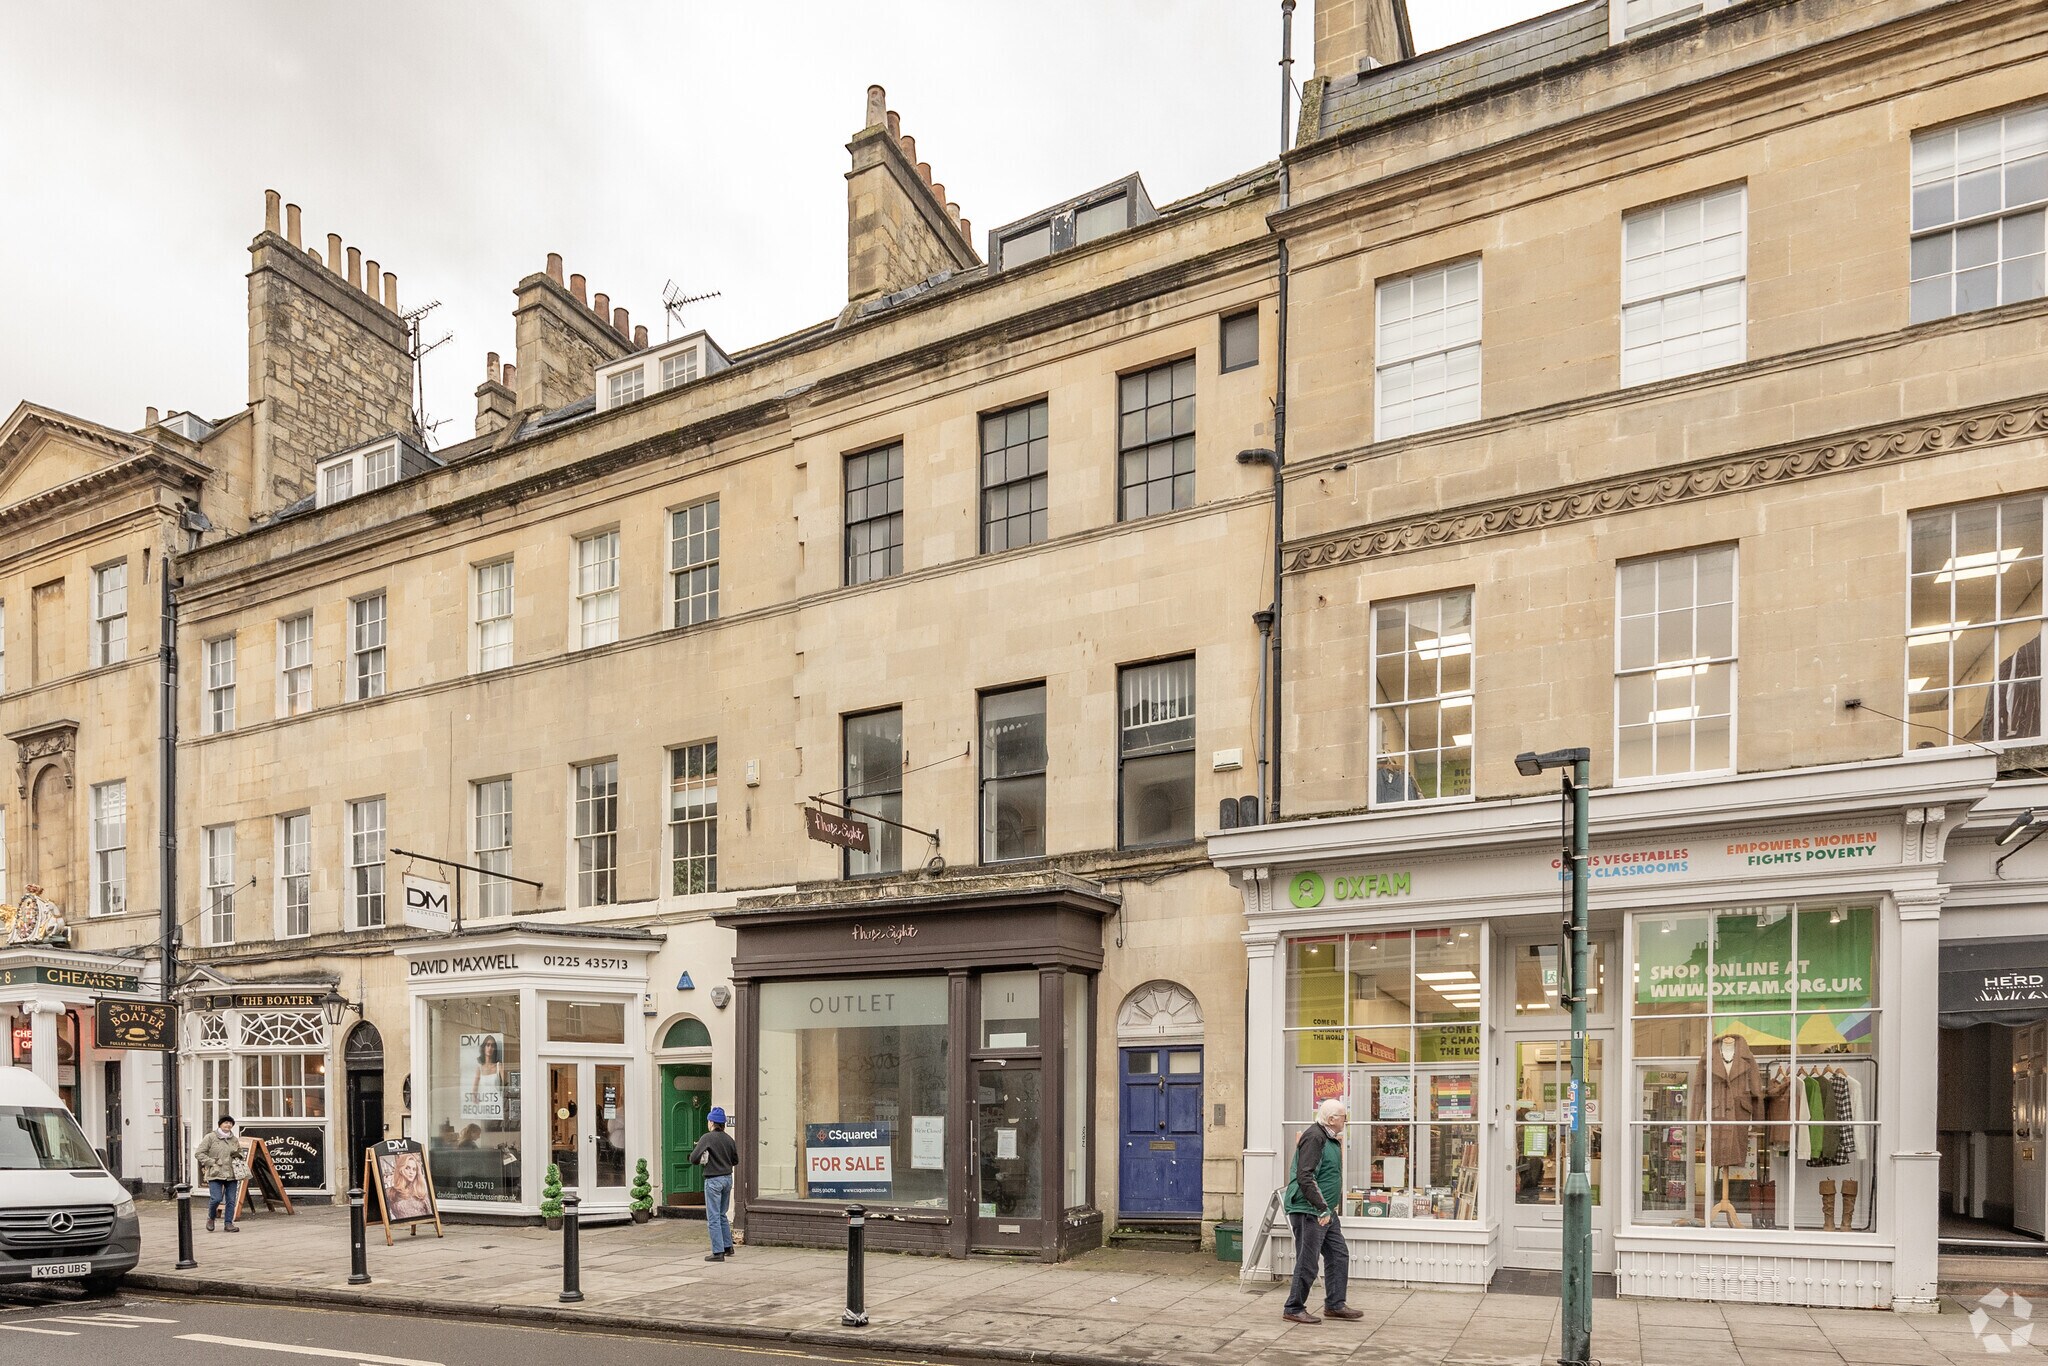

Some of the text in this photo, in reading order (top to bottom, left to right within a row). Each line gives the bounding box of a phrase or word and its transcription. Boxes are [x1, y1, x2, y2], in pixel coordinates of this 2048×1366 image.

[842, 822, 865, 845] Eight
[1726, 832, 1877, 855] EMPOWERS WOMEN
[1603, 848, 1689, 865] VEGETABLES
[1748, 845, 1877, 866] FIGHTS POVERTY
[1595, 861, 1689, 878] CLASSROOMS
[1333, 871, 1411, 900] OXFAM
[406, 887, 448, 913] DM
[886, 924, 918, 945] Eight
[410, 953, 519, 976] DAVID MAXWELL
[543, 956, 628, 970] 01225 435713
[1650, 960, 1810, 980] SHOP ONLINE AT
[4, 971, 11, 984] 8
[46, 969, 126, 989] CHEMIST
[1984, 975, 2044, 987] HERD
[1650, 977, 1863, 998] WWW.OXFAM.ORG.UK
[129, 1004, 146, 1012] THE
[241, 996, 314, 1006] THE BOATER
[809, 993, 895, 1014] OUTLET
[110, 1012, 165, 1031] BOATER
[14, 1030, 32, 1038] CHE
[1440, 1025, 1472, 1034] COME
[1575, 1031, 1580, 1039] 1
[461, 1035, 480, 1047] DM
[1450, 1036, 1480, 1045] CHAN
[1440, 1047, 1460, 1056] THE
[465, 1092, 498, 1102] STYLISTS
[462, 1105, 501, 1115] REQUIRED
[828, 1128, 878, 1142] CSquared
[264, 1136, 318, 1156] rside Garden
[270, 1147, 294, 1156] Fresh
[387, 1139, 408, 1150] DM
[811, 1156, 886, 1172] FOR SALE
[457, 1181, 495, 1190] 01225 435713
[37, 1264, 87, 1276] KY68 UBS
